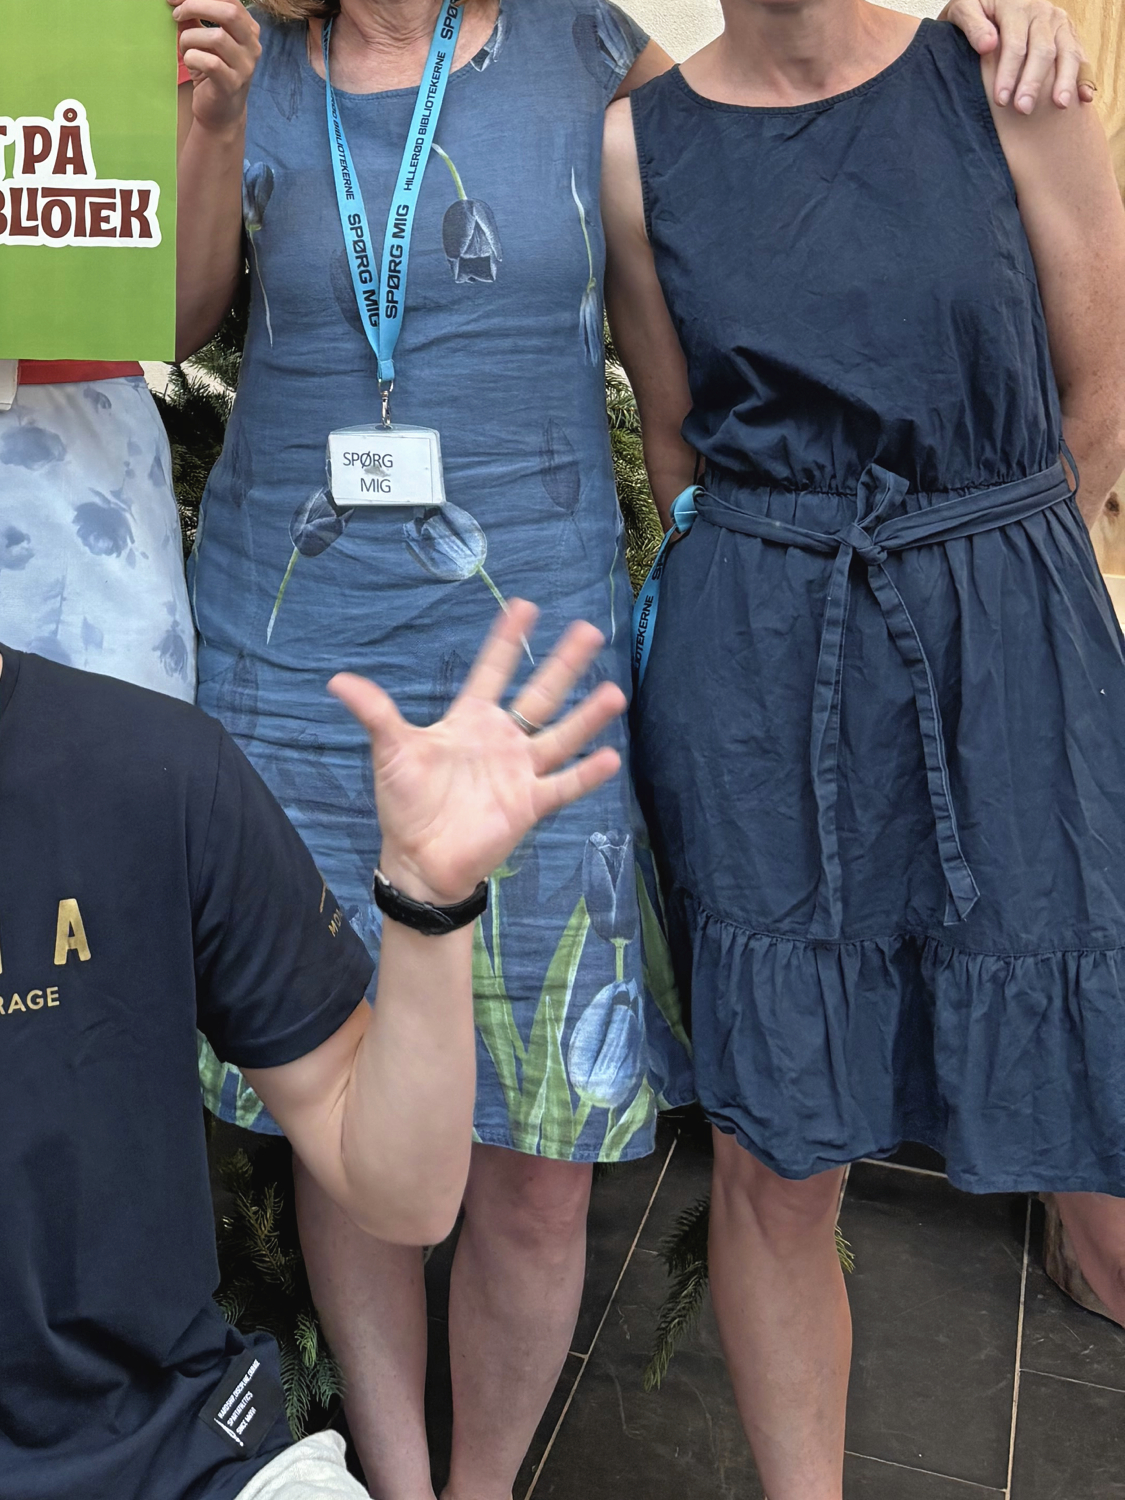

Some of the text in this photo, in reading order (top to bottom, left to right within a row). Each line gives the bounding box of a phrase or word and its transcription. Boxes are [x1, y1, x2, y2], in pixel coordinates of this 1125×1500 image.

[22, 106, 95, 176] PÅ
[404, 49, 446, 192] HILLERØD BIBLIOTEKERNE
[348, 213, 379, 329] SPØRG MIG
[385, 204, 409, 320] SPØRG MIG
[342, 451, 394, 469] SPØRG
[360, 478, 391, 494] MIG
